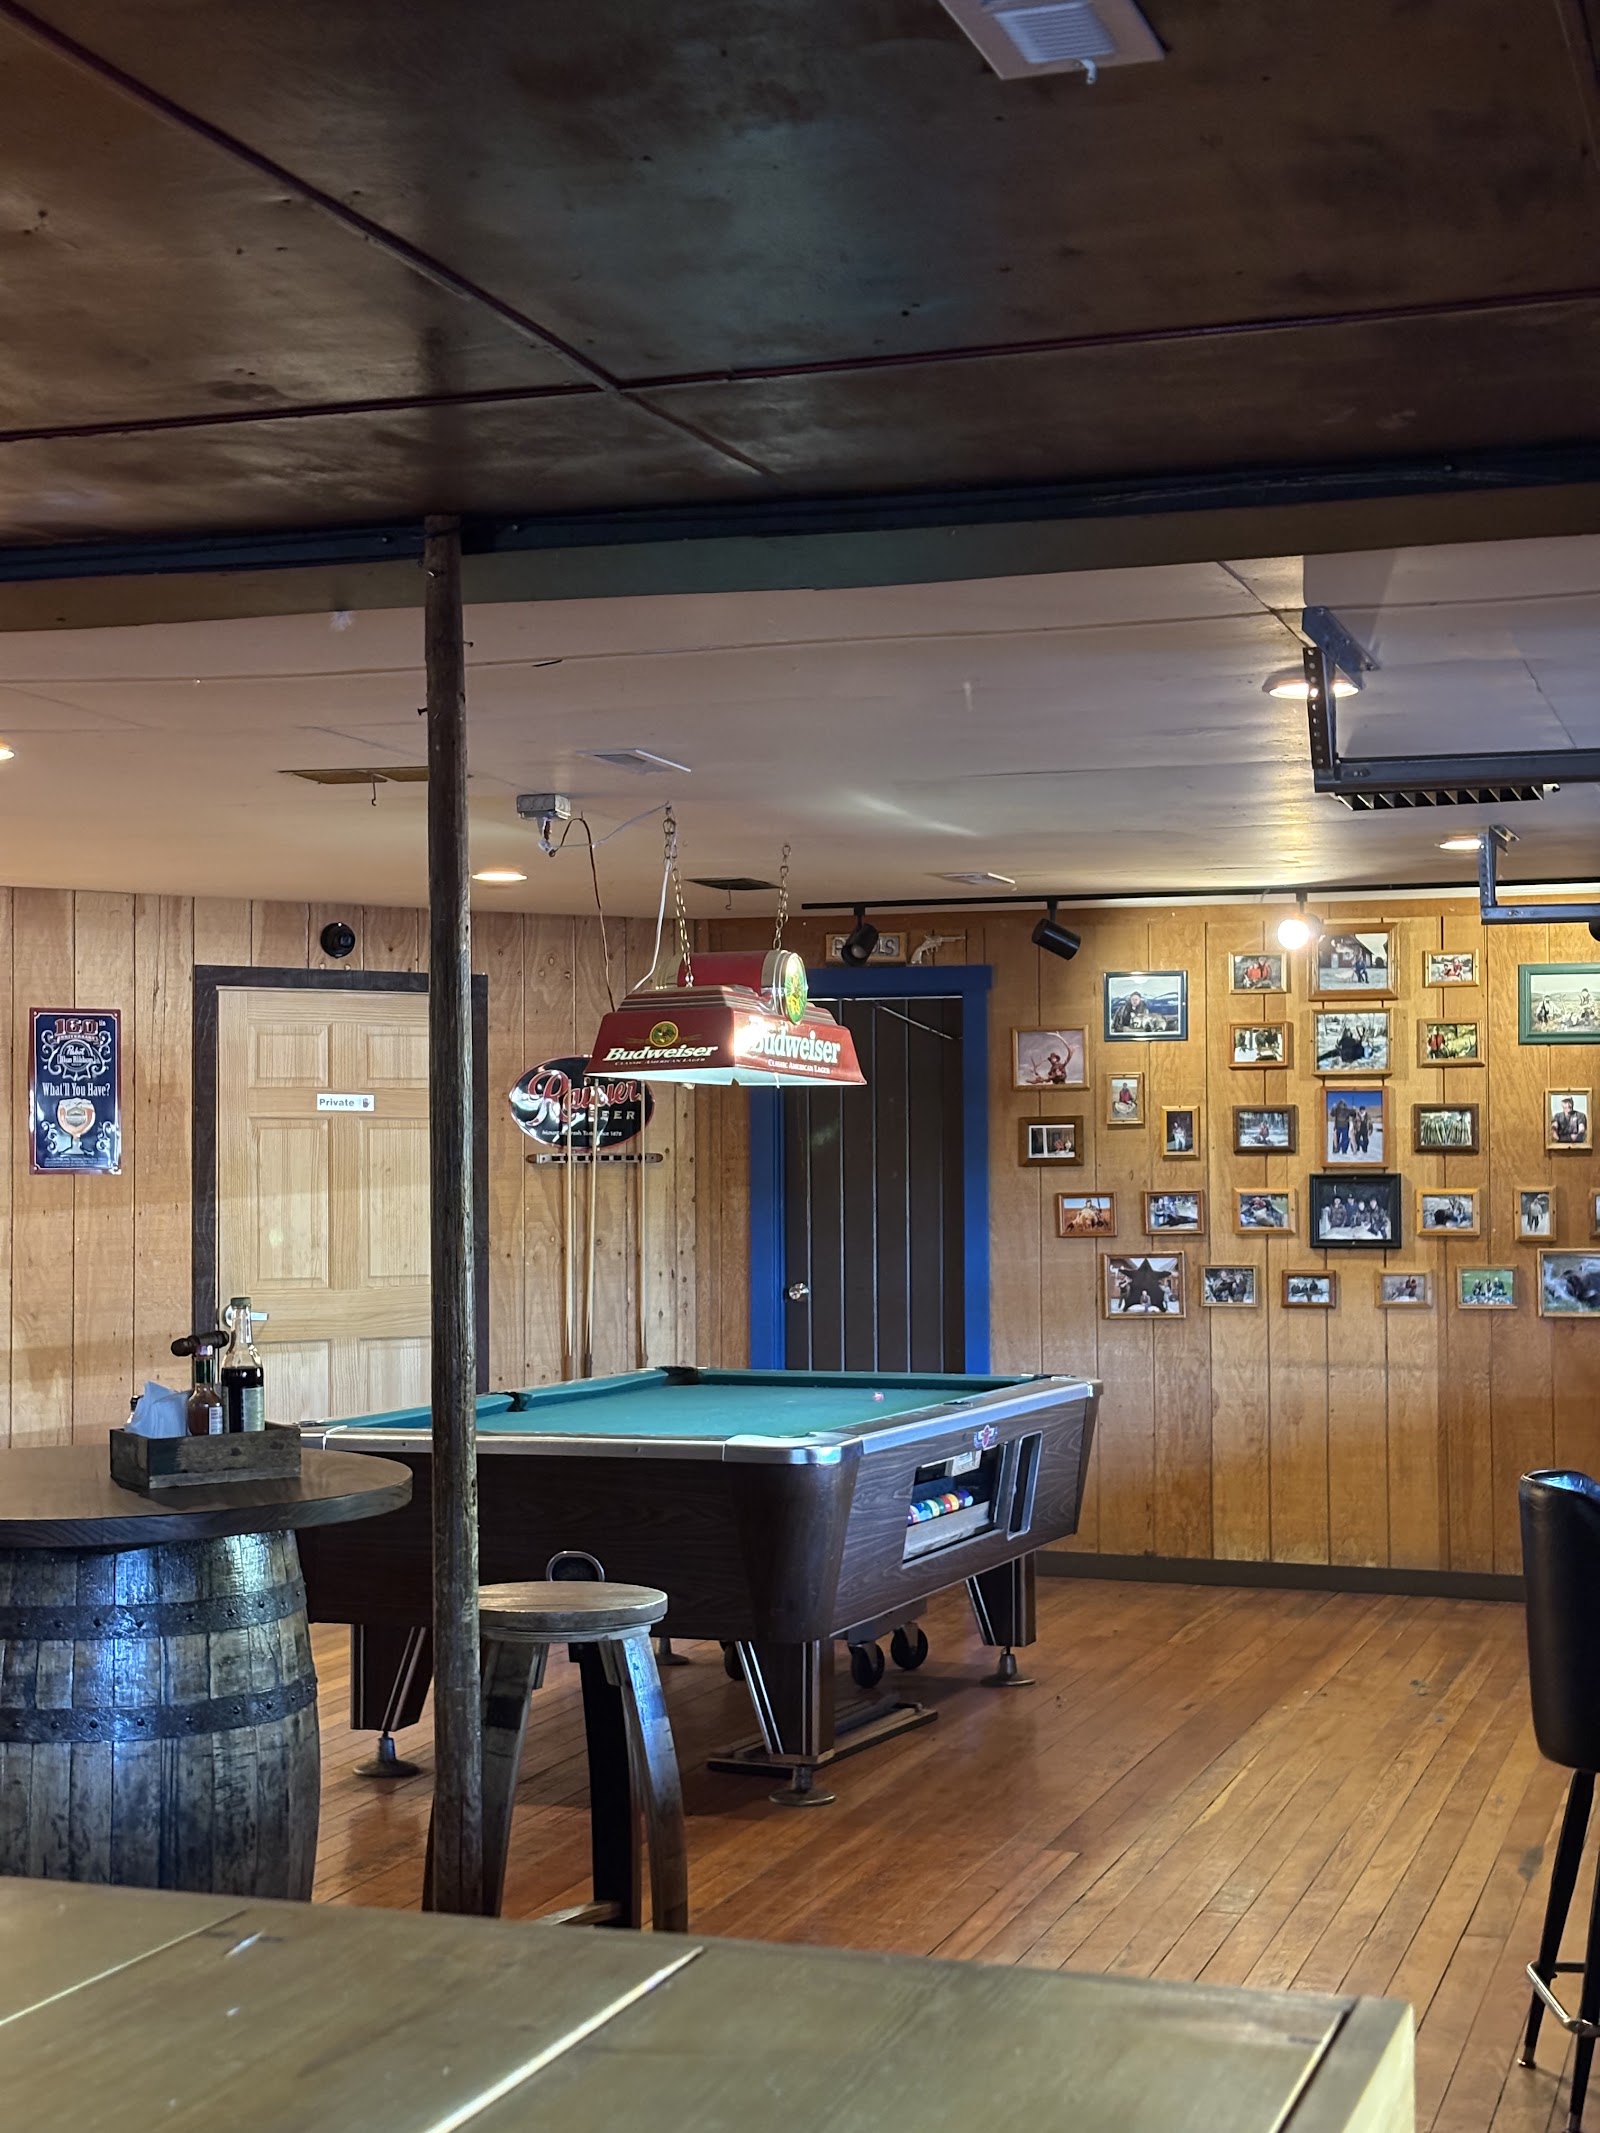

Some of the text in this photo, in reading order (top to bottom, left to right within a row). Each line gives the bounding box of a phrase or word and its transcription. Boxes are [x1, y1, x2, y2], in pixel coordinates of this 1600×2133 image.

[602, 1044, 719, 1062] Budweiser
[42, 1082, 111, 1096] What'll You Have?
[319, 1098, 355, 1107] Private
